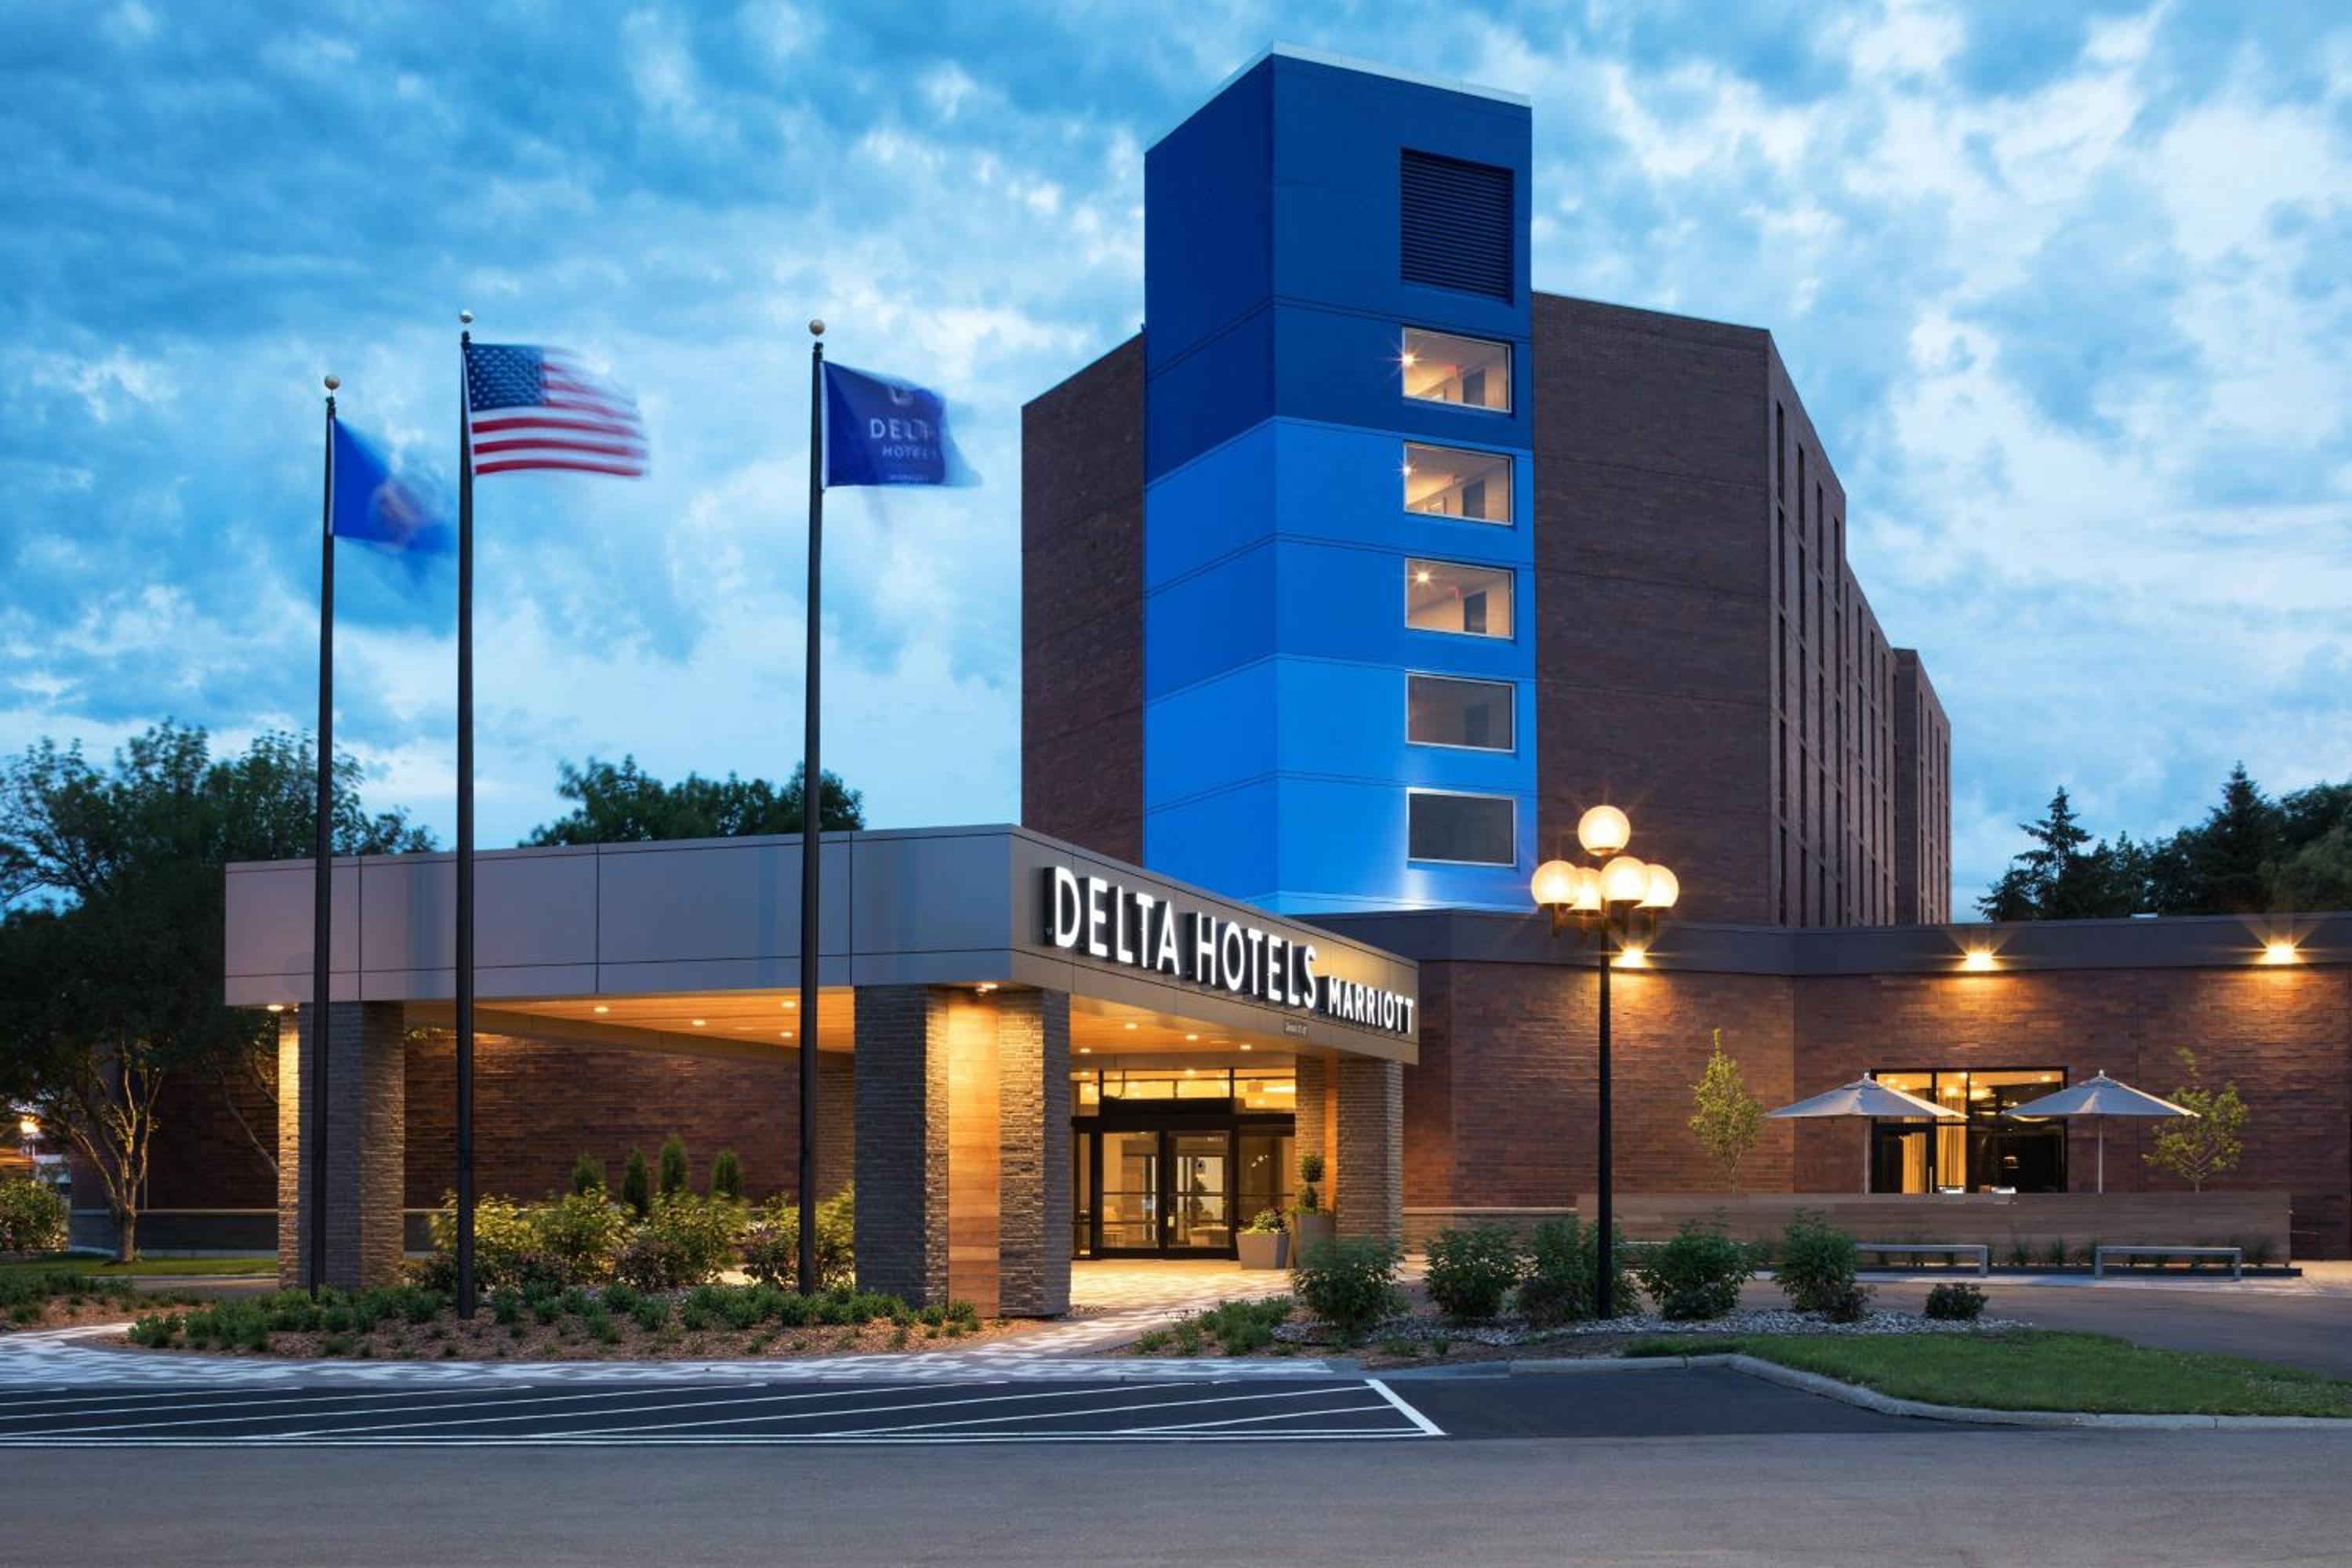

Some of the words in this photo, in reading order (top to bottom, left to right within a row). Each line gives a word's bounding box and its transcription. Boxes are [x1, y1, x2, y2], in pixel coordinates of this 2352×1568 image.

[869, 418, 937, 441] DELT
[1054, 866, 1180, 975] DELTA
[1196, 912, 1318, 1009] HOTELS
[1327, 975, 1414, 1035] MARRIOTT
